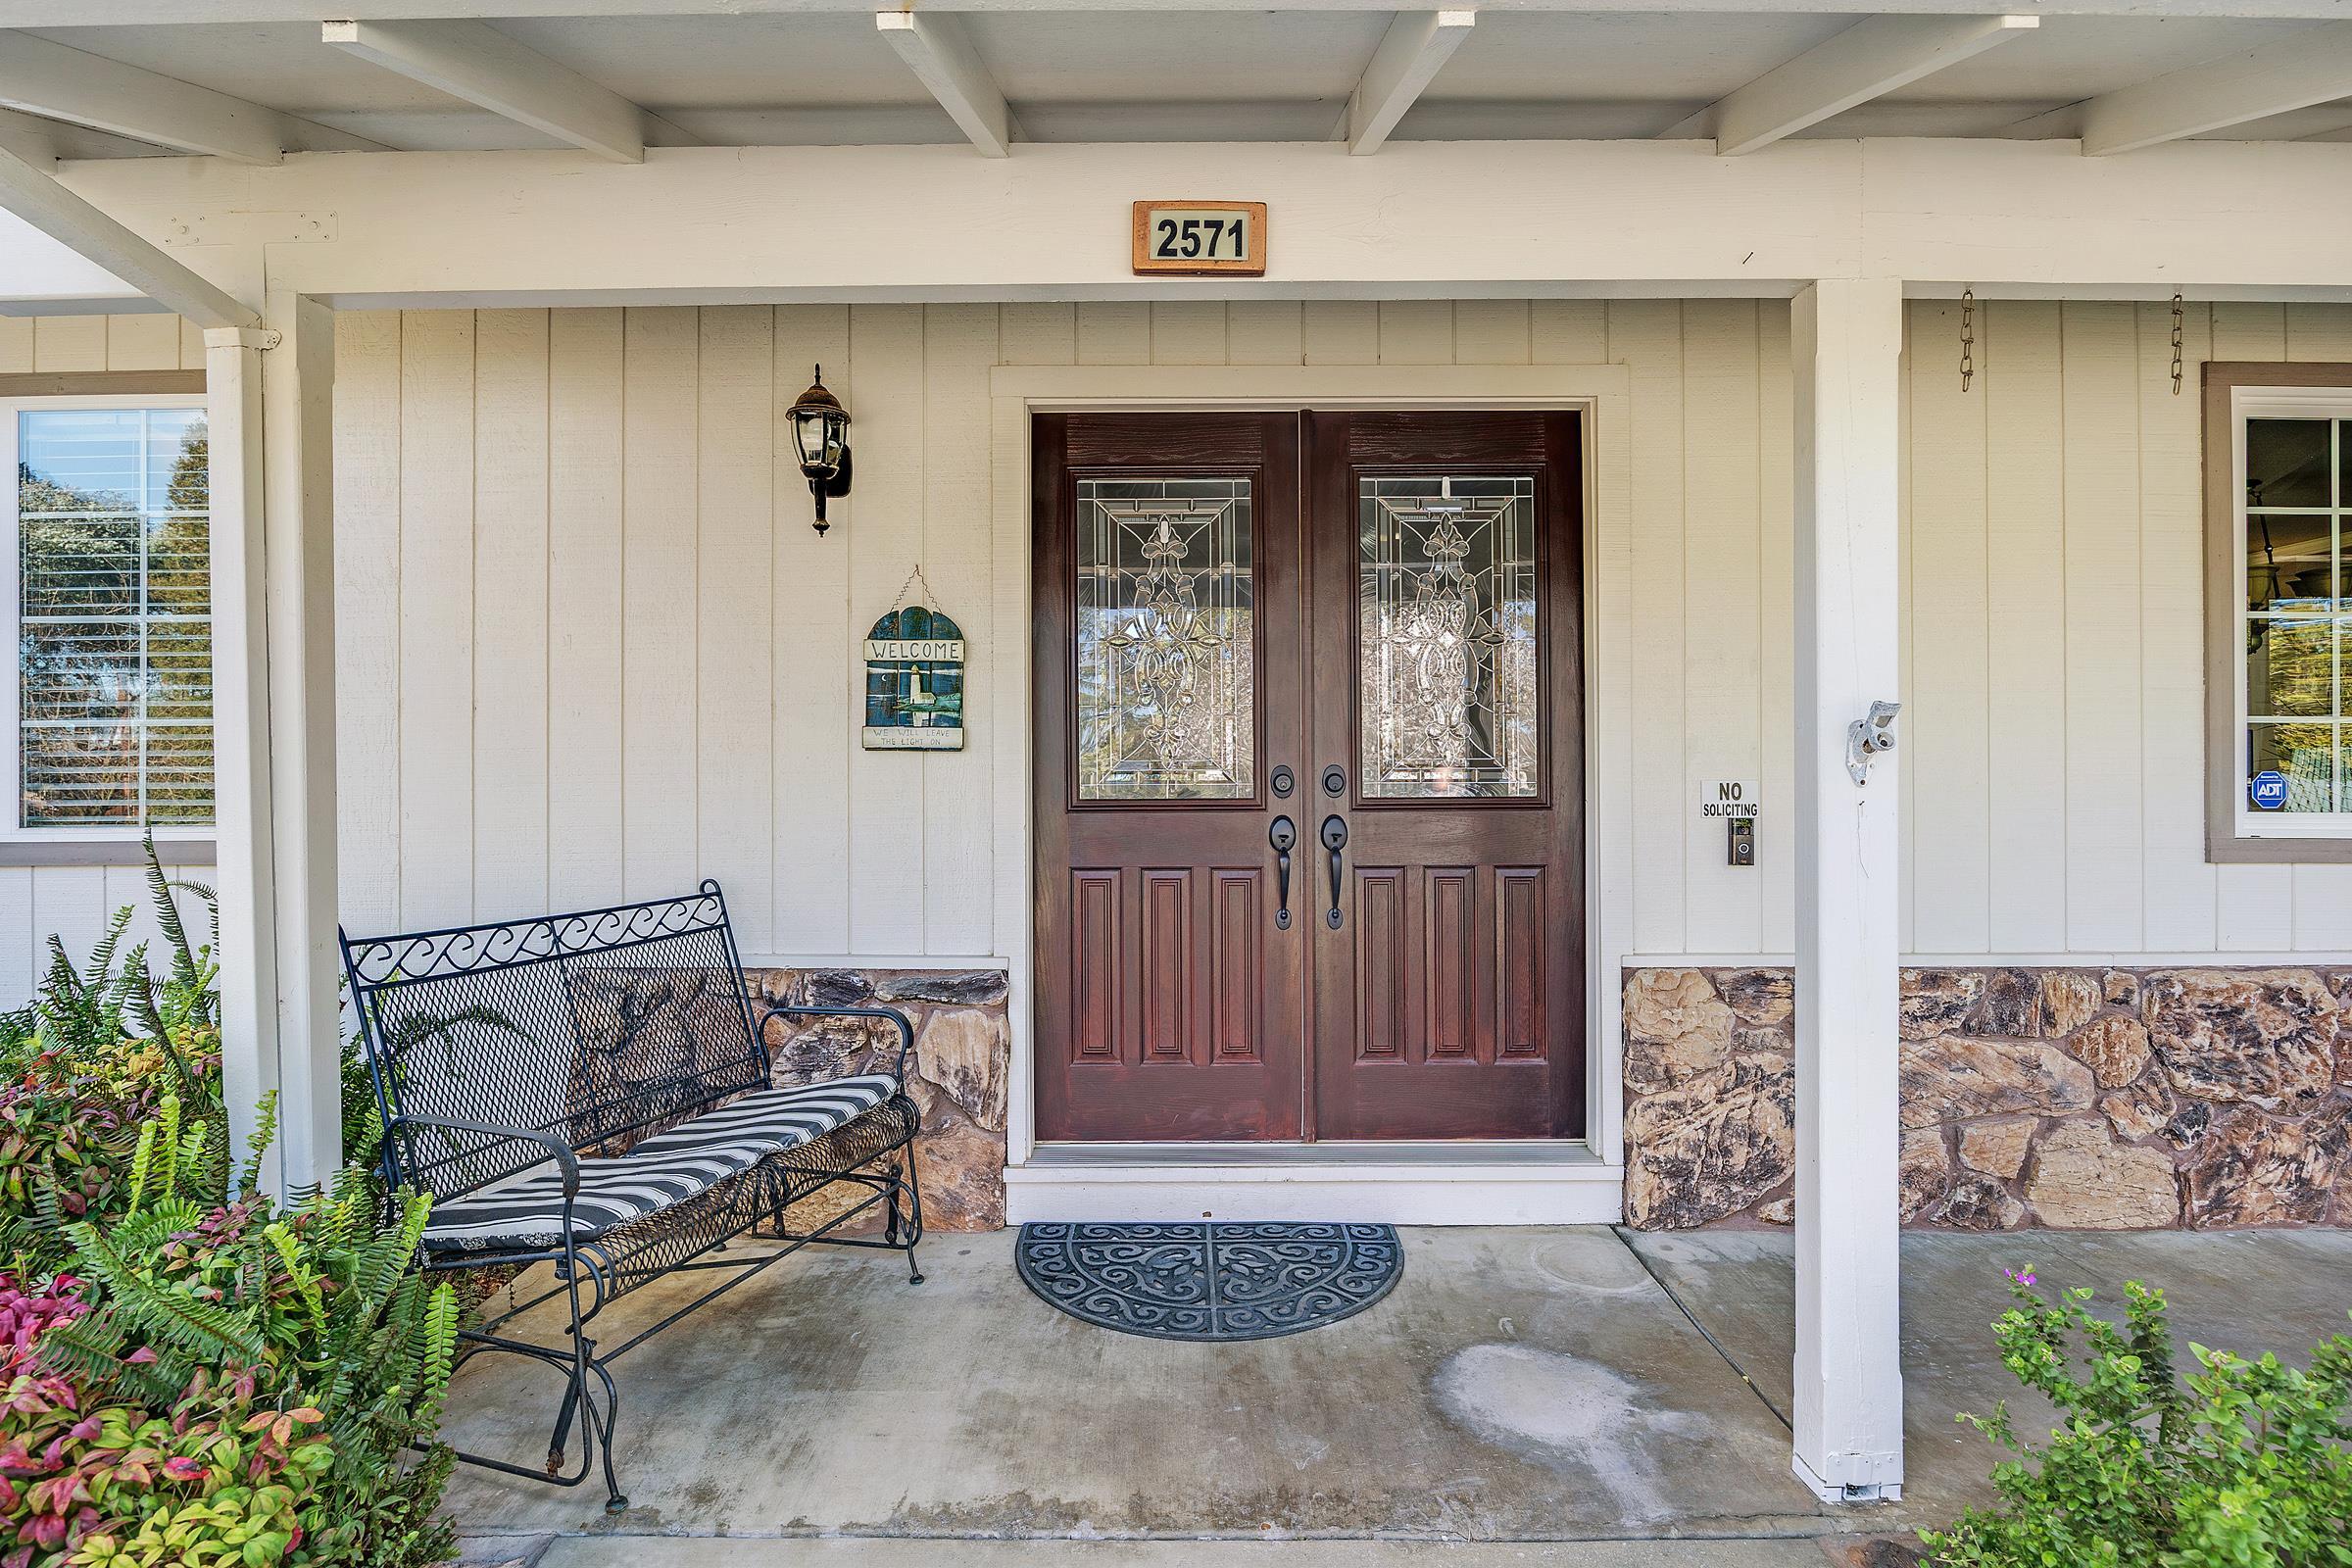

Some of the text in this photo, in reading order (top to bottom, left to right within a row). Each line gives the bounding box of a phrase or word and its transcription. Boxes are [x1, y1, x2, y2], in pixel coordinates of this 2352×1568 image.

[1156, 219, 1243, 258] 2571
[871, 642, 959, 659] WELCOME
[873, 728, 950, 737] WE WILL LEAVE
[881, 737, 896, 746] THE
[901, 737, 924, 746] LIGHT
[1719, 782, 1742, 801] NO
[2258, 783, 2282, 796] ADT
[1703, 803, 1758, 816] SOLICITING
